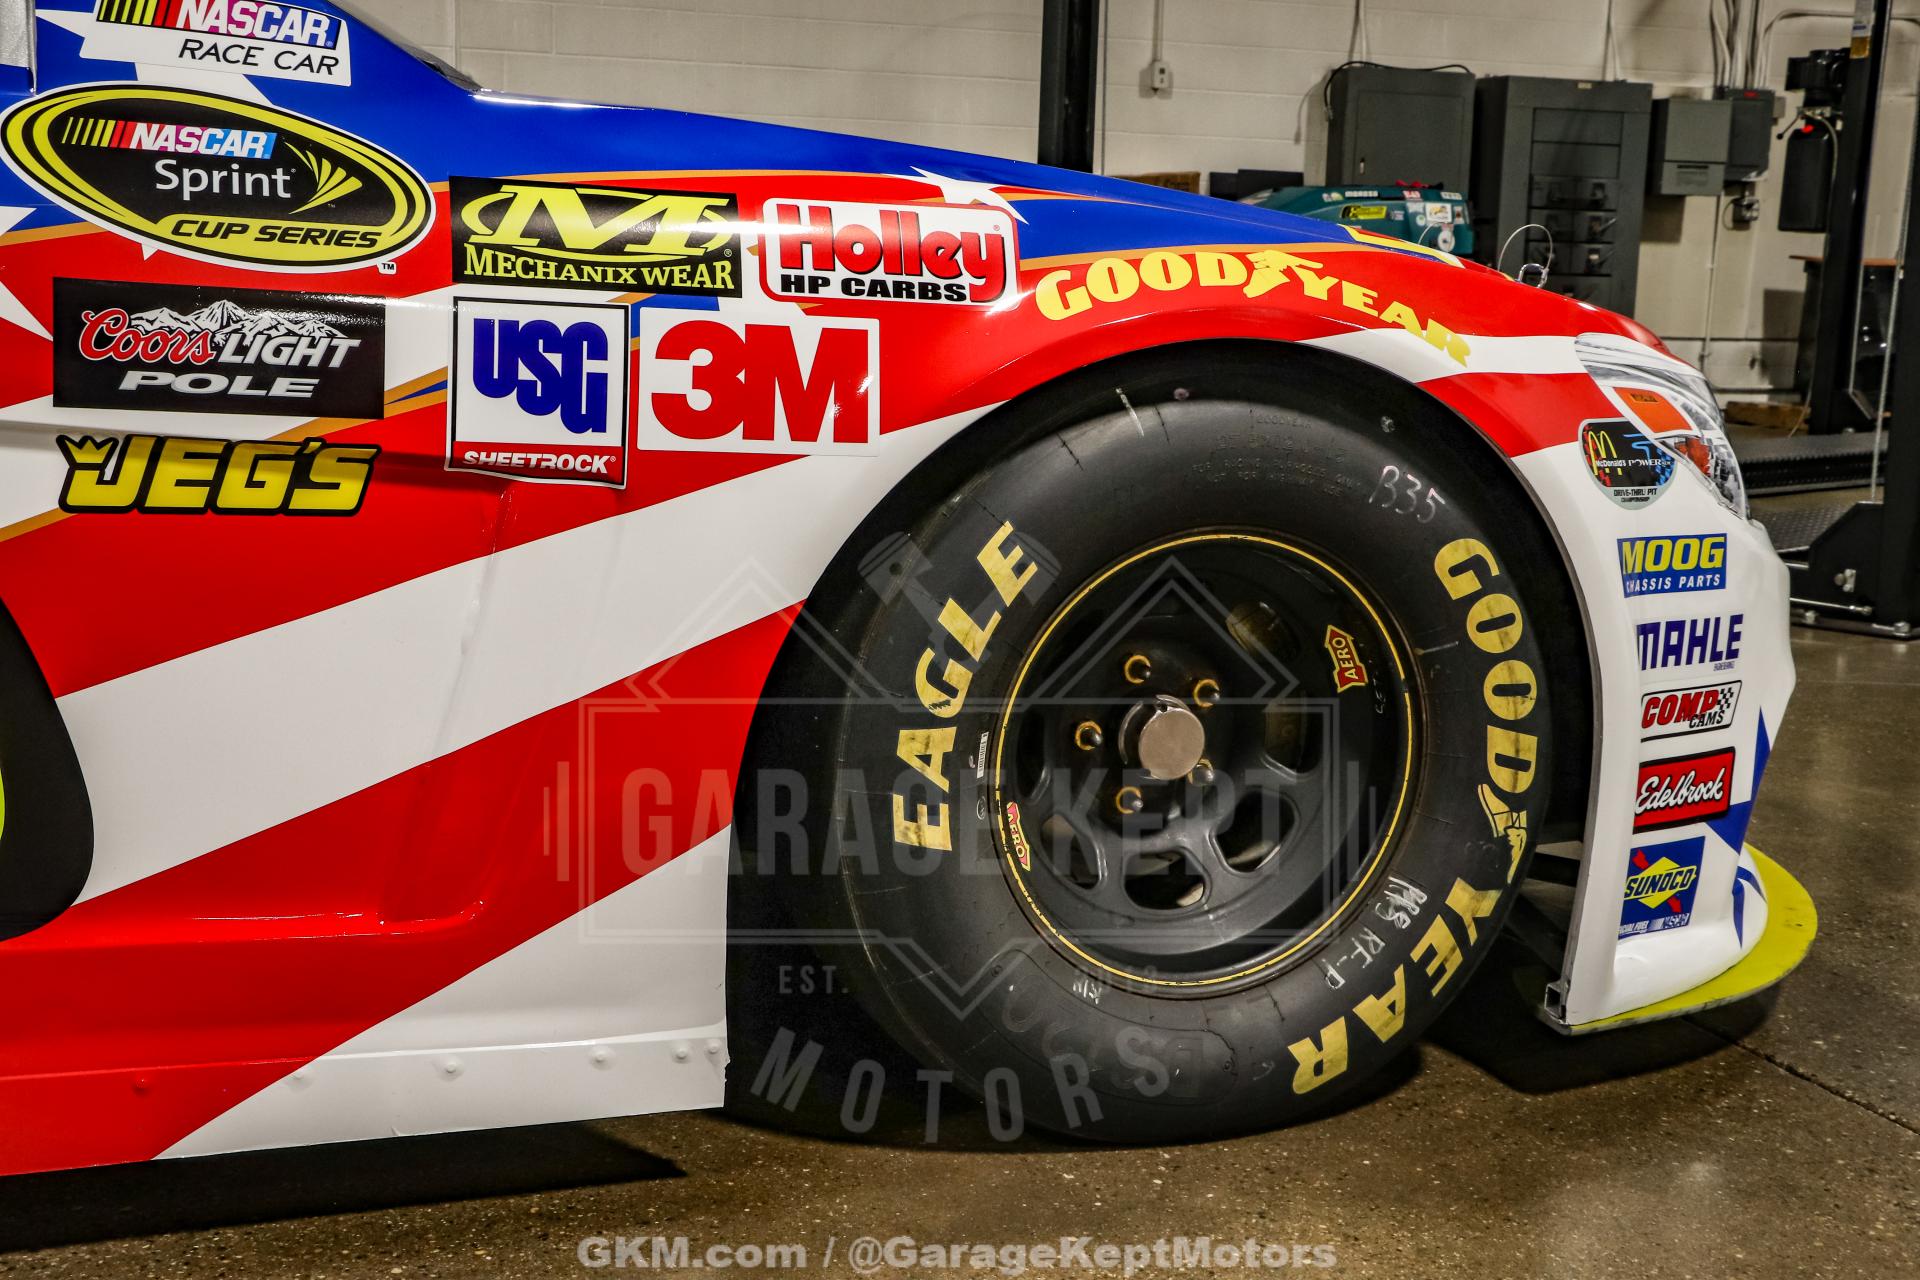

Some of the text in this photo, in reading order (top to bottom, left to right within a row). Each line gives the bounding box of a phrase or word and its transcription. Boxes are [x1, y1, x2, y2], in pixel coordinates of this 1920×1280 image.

[176, 0, 330, 47] NASCAR
[178, 38, 339, 76] RACE CAR
[129, 122, 267, 158] NASCAR
[155, 159, 292, 200] Sprint
[170, 219, 382, 249] CUP SERIES
[776, 203, 1008, 303] Holley
[463, 242, 736, 290] MECHANIX WEAR
[780, 274, 968, 303] HP CARBS
[1035, 251, 1472, 367] GOODYEAR
[78, 307, 362, 369] Coors LIGHT
[118, 370, 321, 398] POLE
[472, 318, 609, 434] USG
[651, 319, 869, 444] 3M
[58, 434, 382, 516] JEG'S
[463, 449, 610, 475] SHEETROCK
[1621, 536, 1725, 575] MOOG
[1625, 573, 1721, 593] CHASSIS PARTS
[1332, 637, 1359, 680] AERO
[1636, 613, 1744, 671] MAHLE
[892, 520, 1039, 852] EAGLE
[1641, 689, 1720, 730] COMP
[1688, 709, 1725, 729] CAMS
[1634, 767, 1726, 815] Edelbrock
[1007, 813, 1025, 858] AERO
[1623, 867, 1695, 899] SUNOCO
